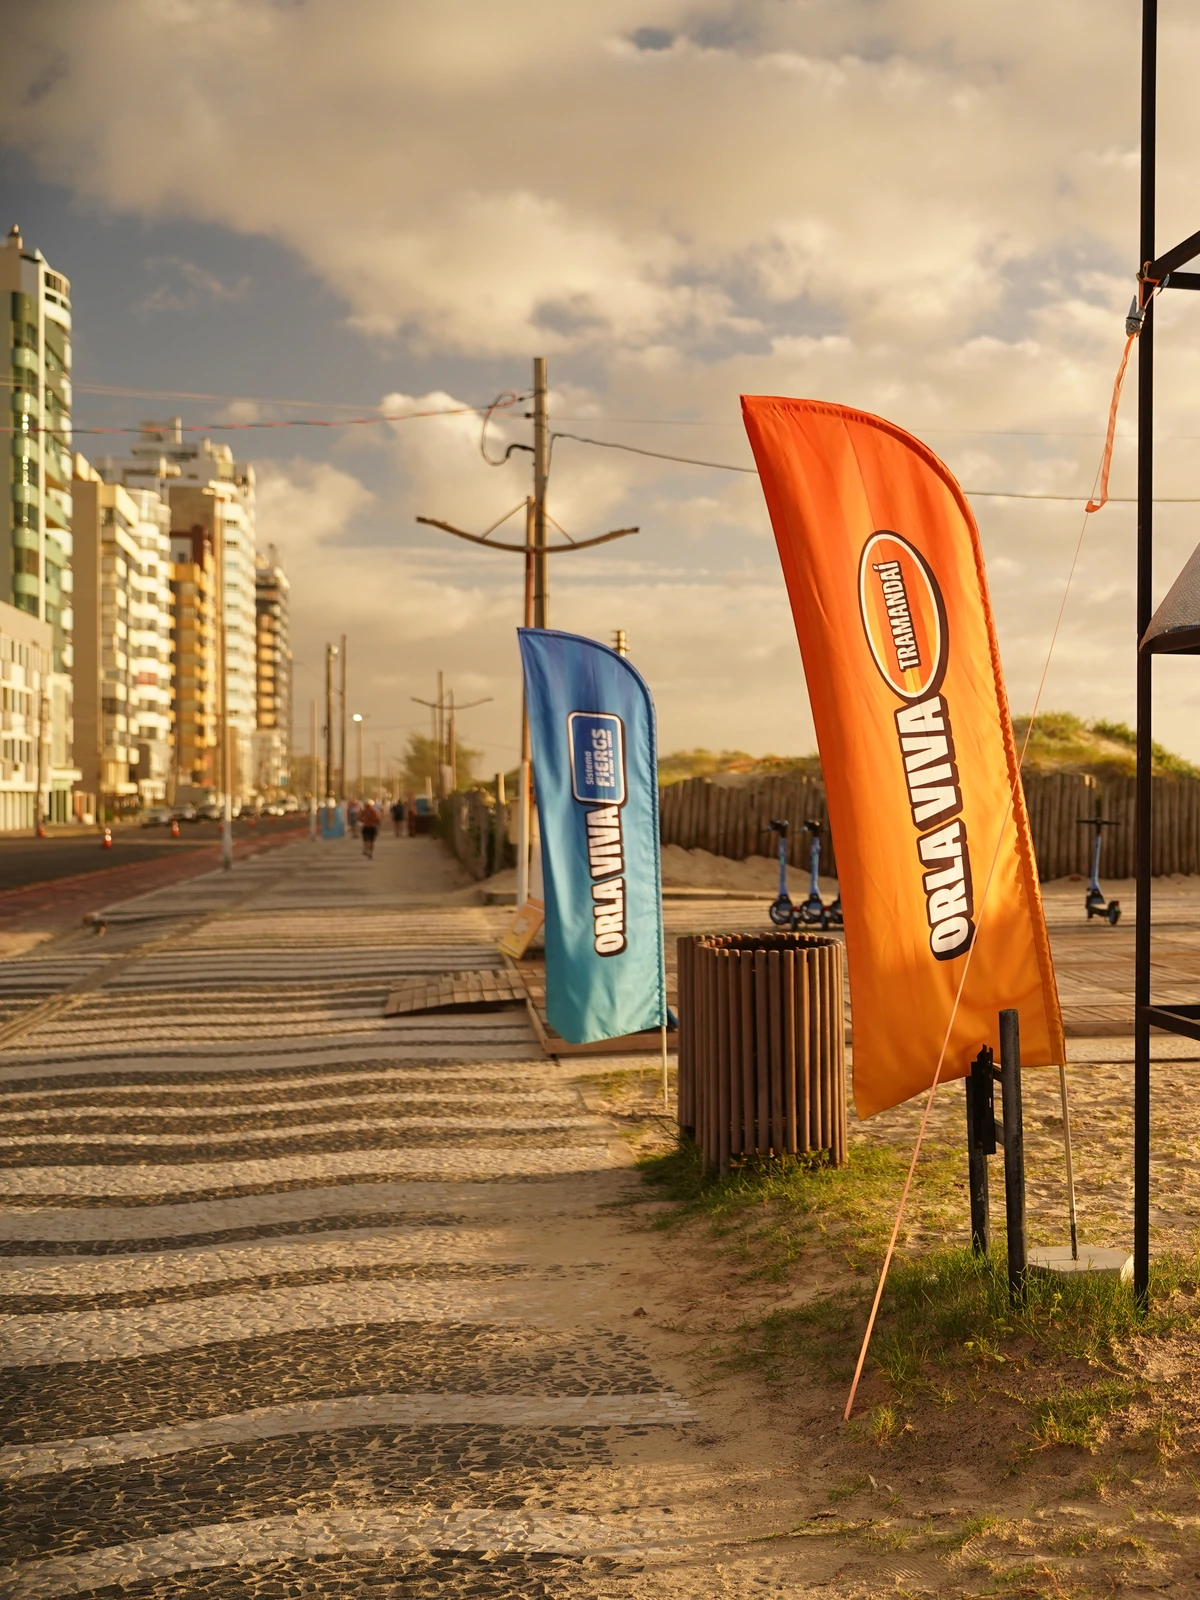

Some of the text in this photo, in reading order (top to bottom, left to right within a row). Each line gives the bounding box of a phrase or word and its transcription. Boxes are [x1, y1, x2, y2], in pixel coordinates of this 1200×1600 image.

[873, 561, 917, 670] TRAMANDAÍ
[585, 750, 595, 786] Sistema
[896, 695, 969, 955] ORLA VIVA
[587, 805, 624, 955] ORLA VIVA
